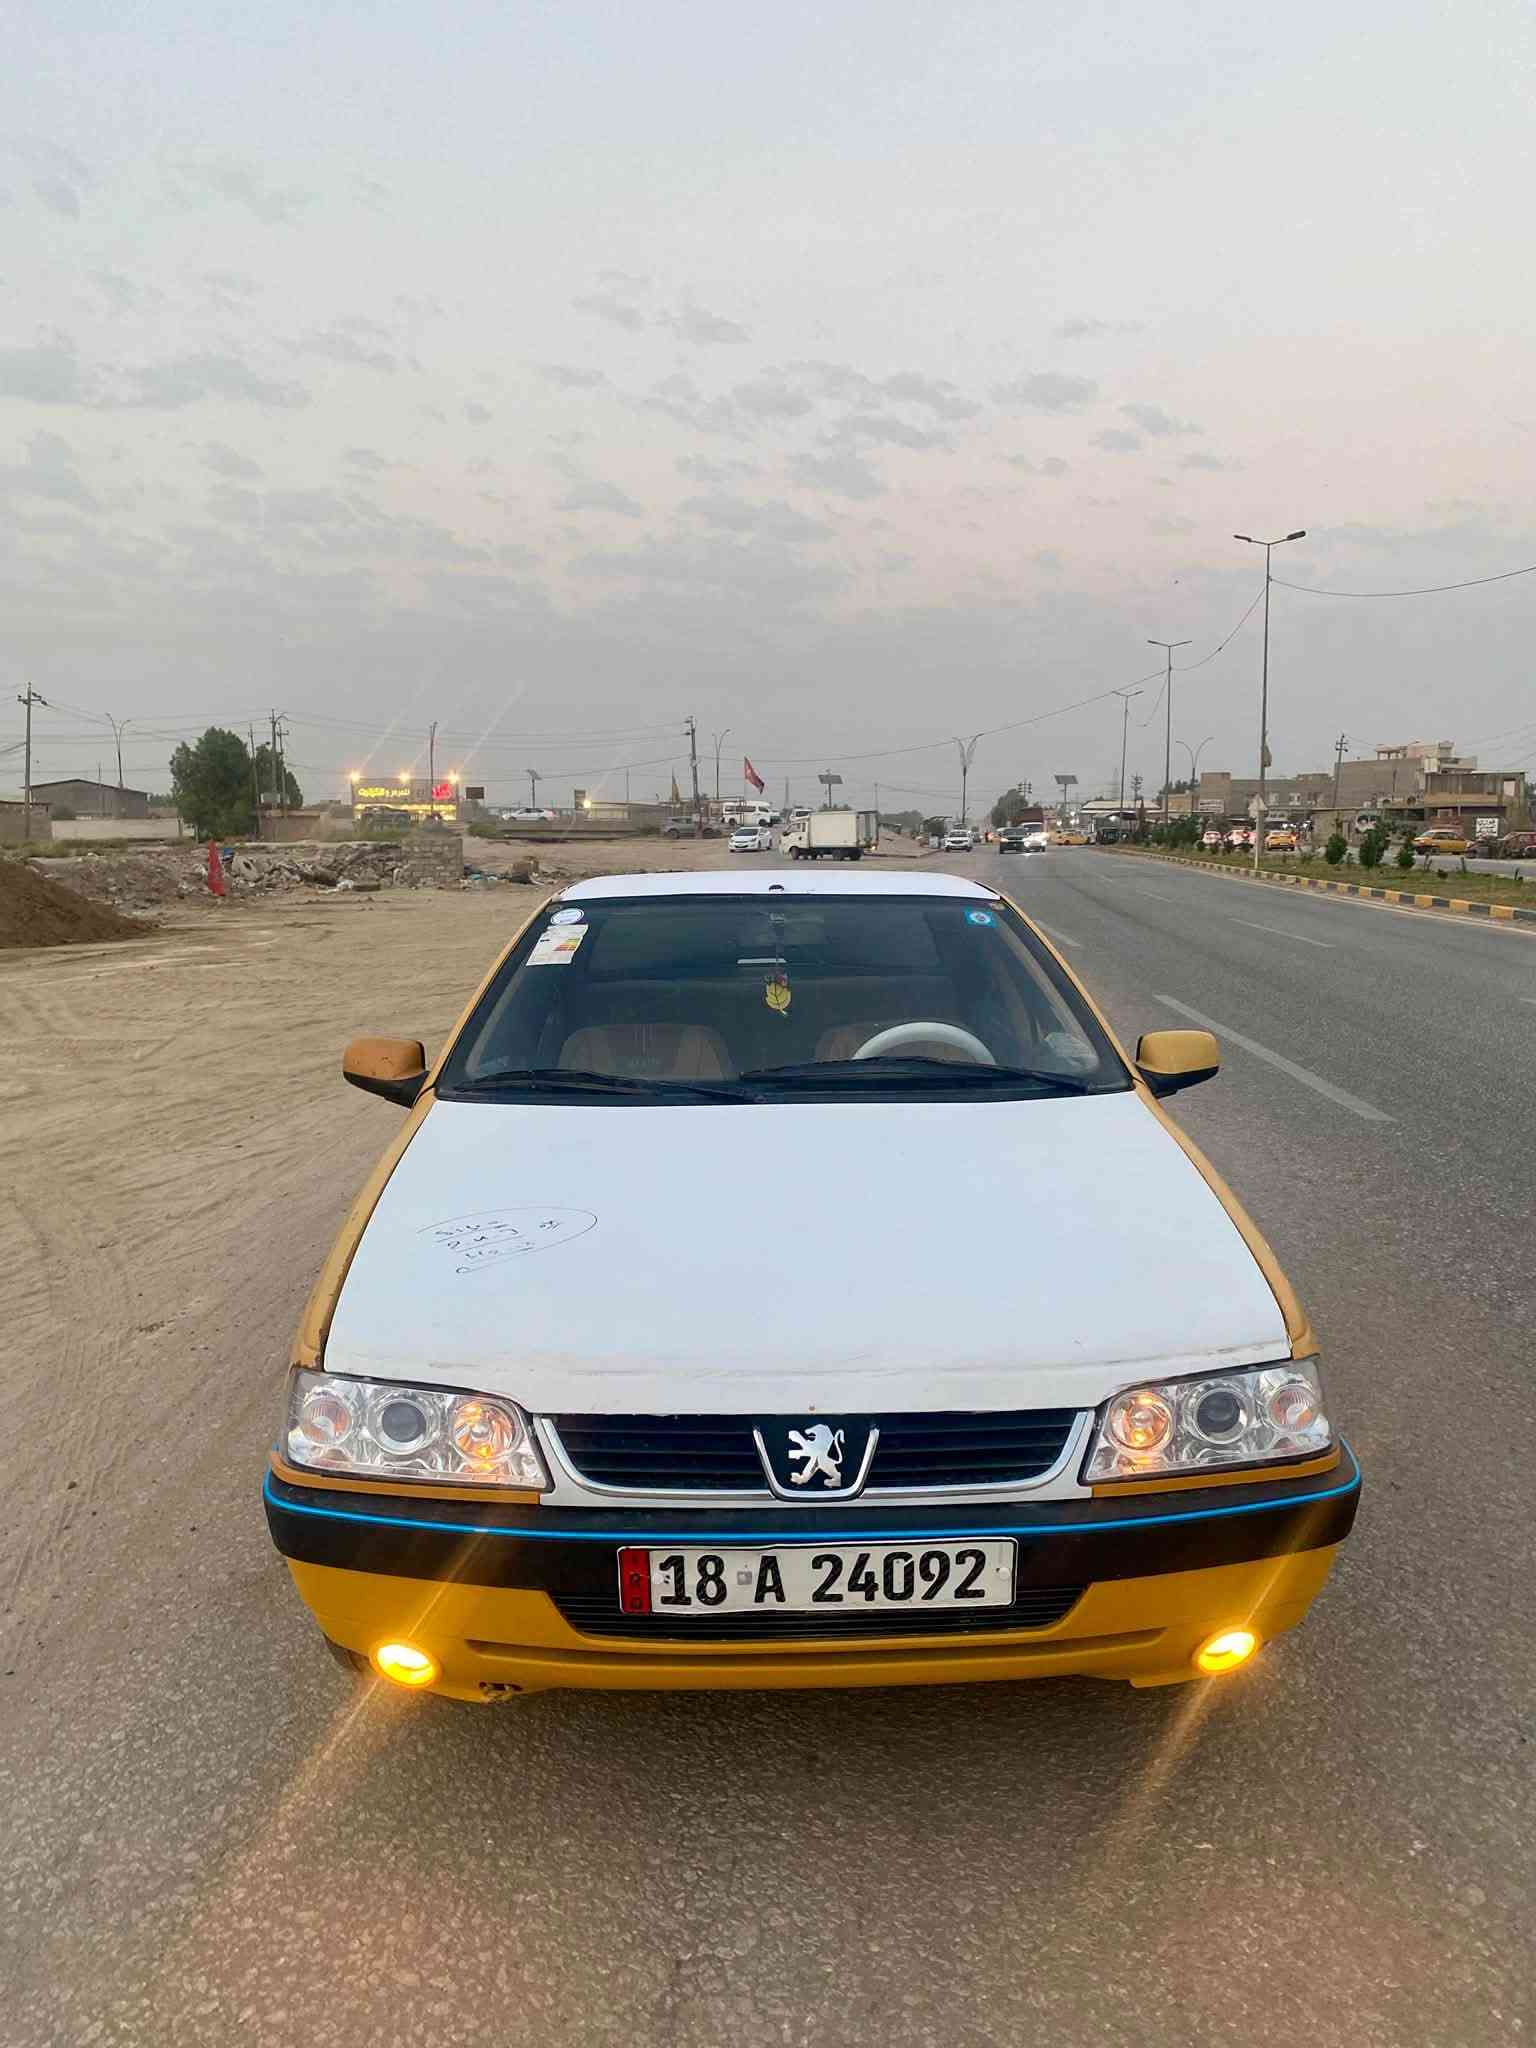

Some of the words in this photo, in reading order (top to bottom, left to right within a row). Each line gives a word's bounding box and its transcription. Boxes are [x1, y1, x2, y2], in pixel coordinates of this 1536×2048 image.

[659, 1555, 728, 1607] 18
[754, 1555, 786, 1604] A
[811, 1548, 987, 1603] 24092
